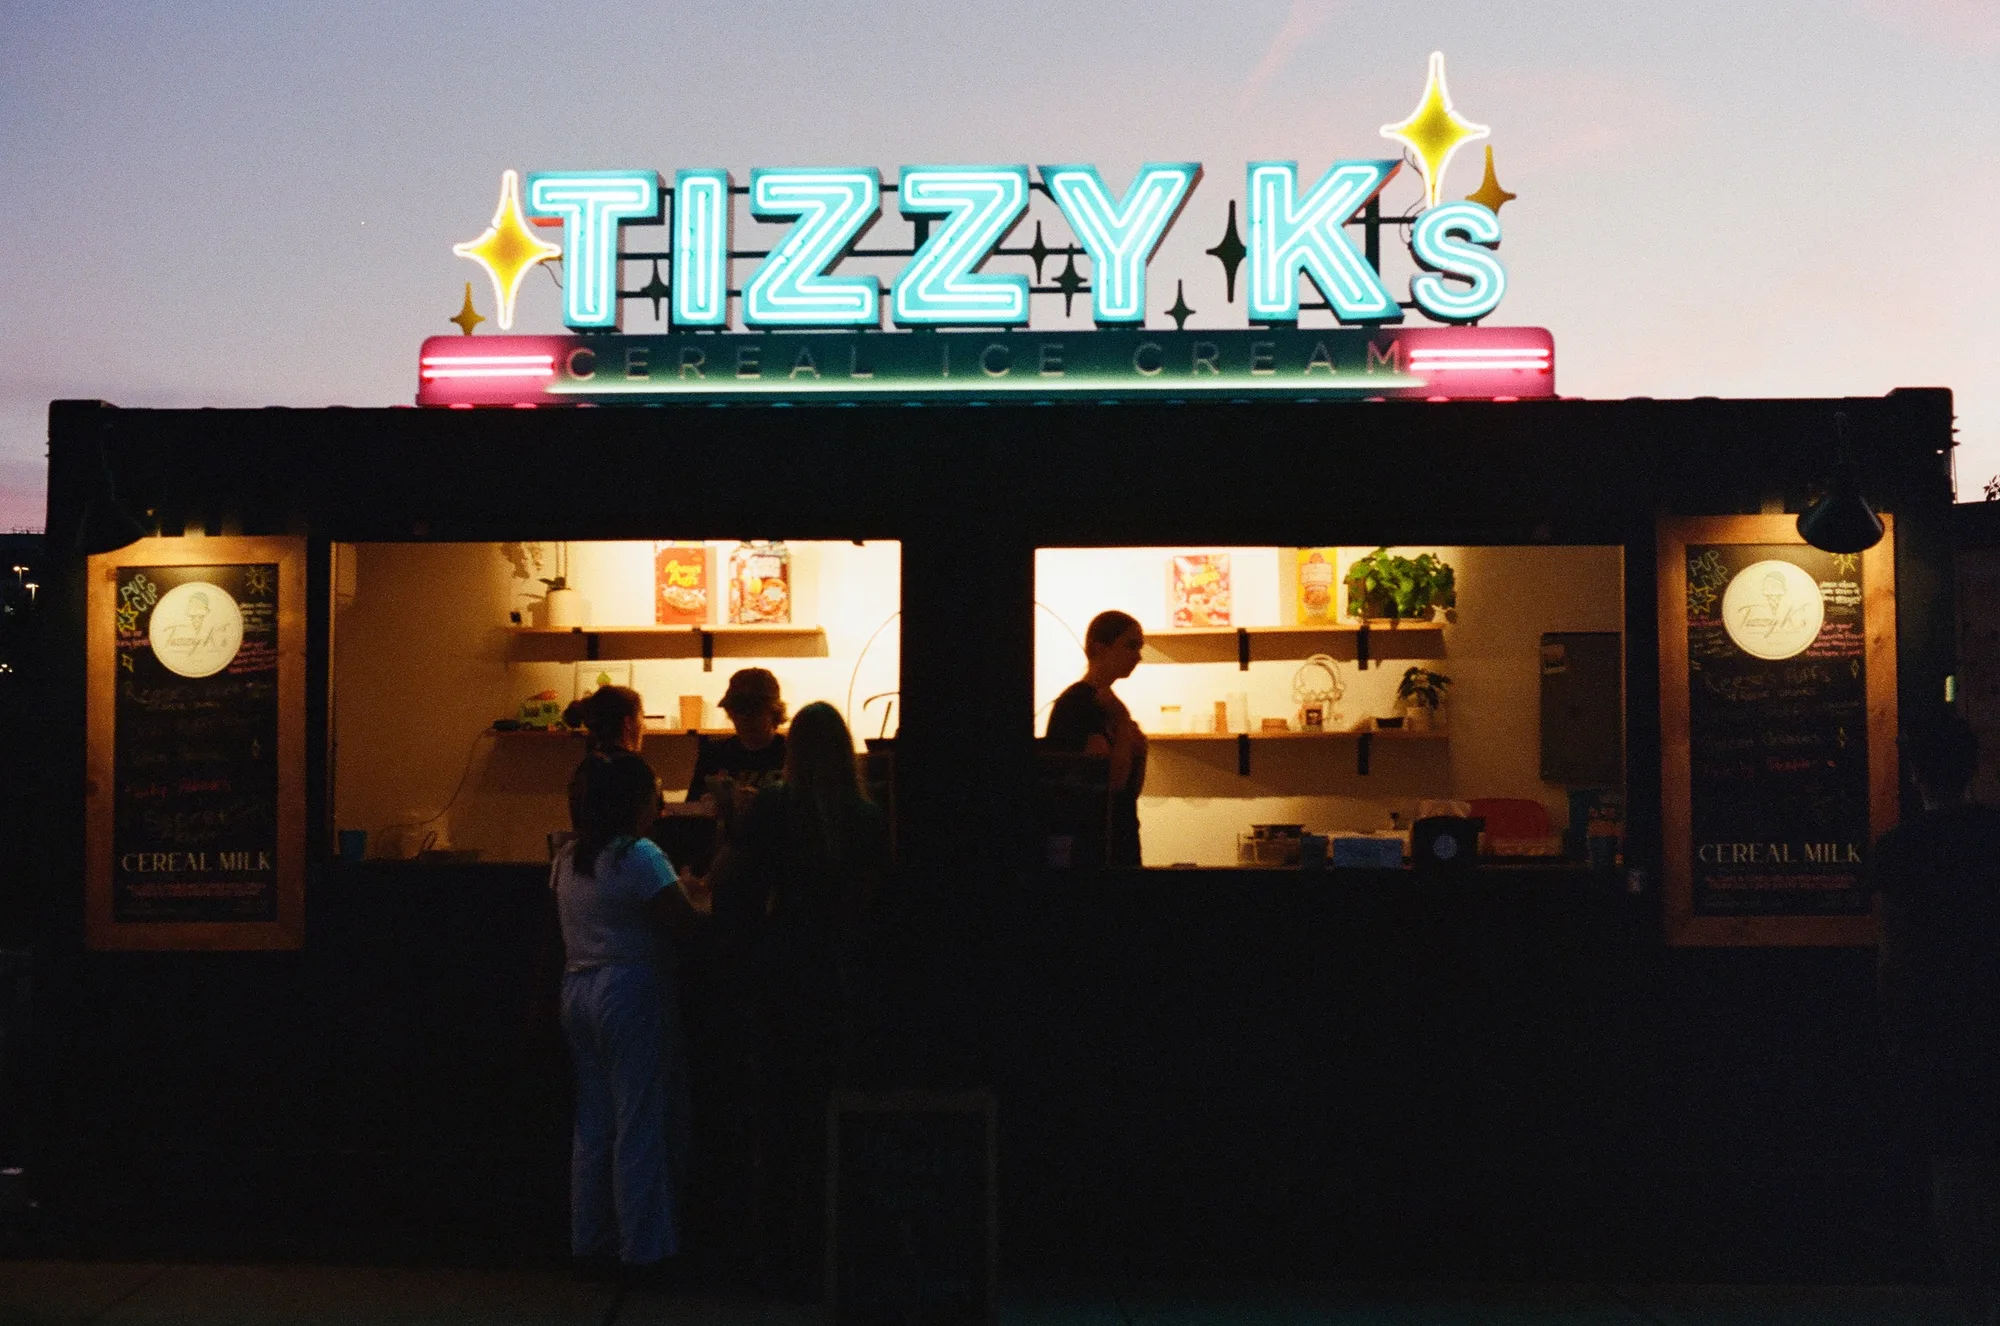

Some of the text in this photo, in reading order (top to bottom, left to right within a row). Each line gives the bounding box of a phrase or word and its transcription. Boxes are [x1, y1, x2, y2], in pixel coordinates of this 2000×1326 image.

[526, 160, 1203, 330] TIZZY
[566, 339, 1401, 381] CEREAL ICE CREAM
[120, 573, 147, 601] PUP
[132, 582, 158, 612] CUP
[121, 850, 271, 872] CEREAL MILK
[1698, 841, 1862, 863] CEREAL MILK
